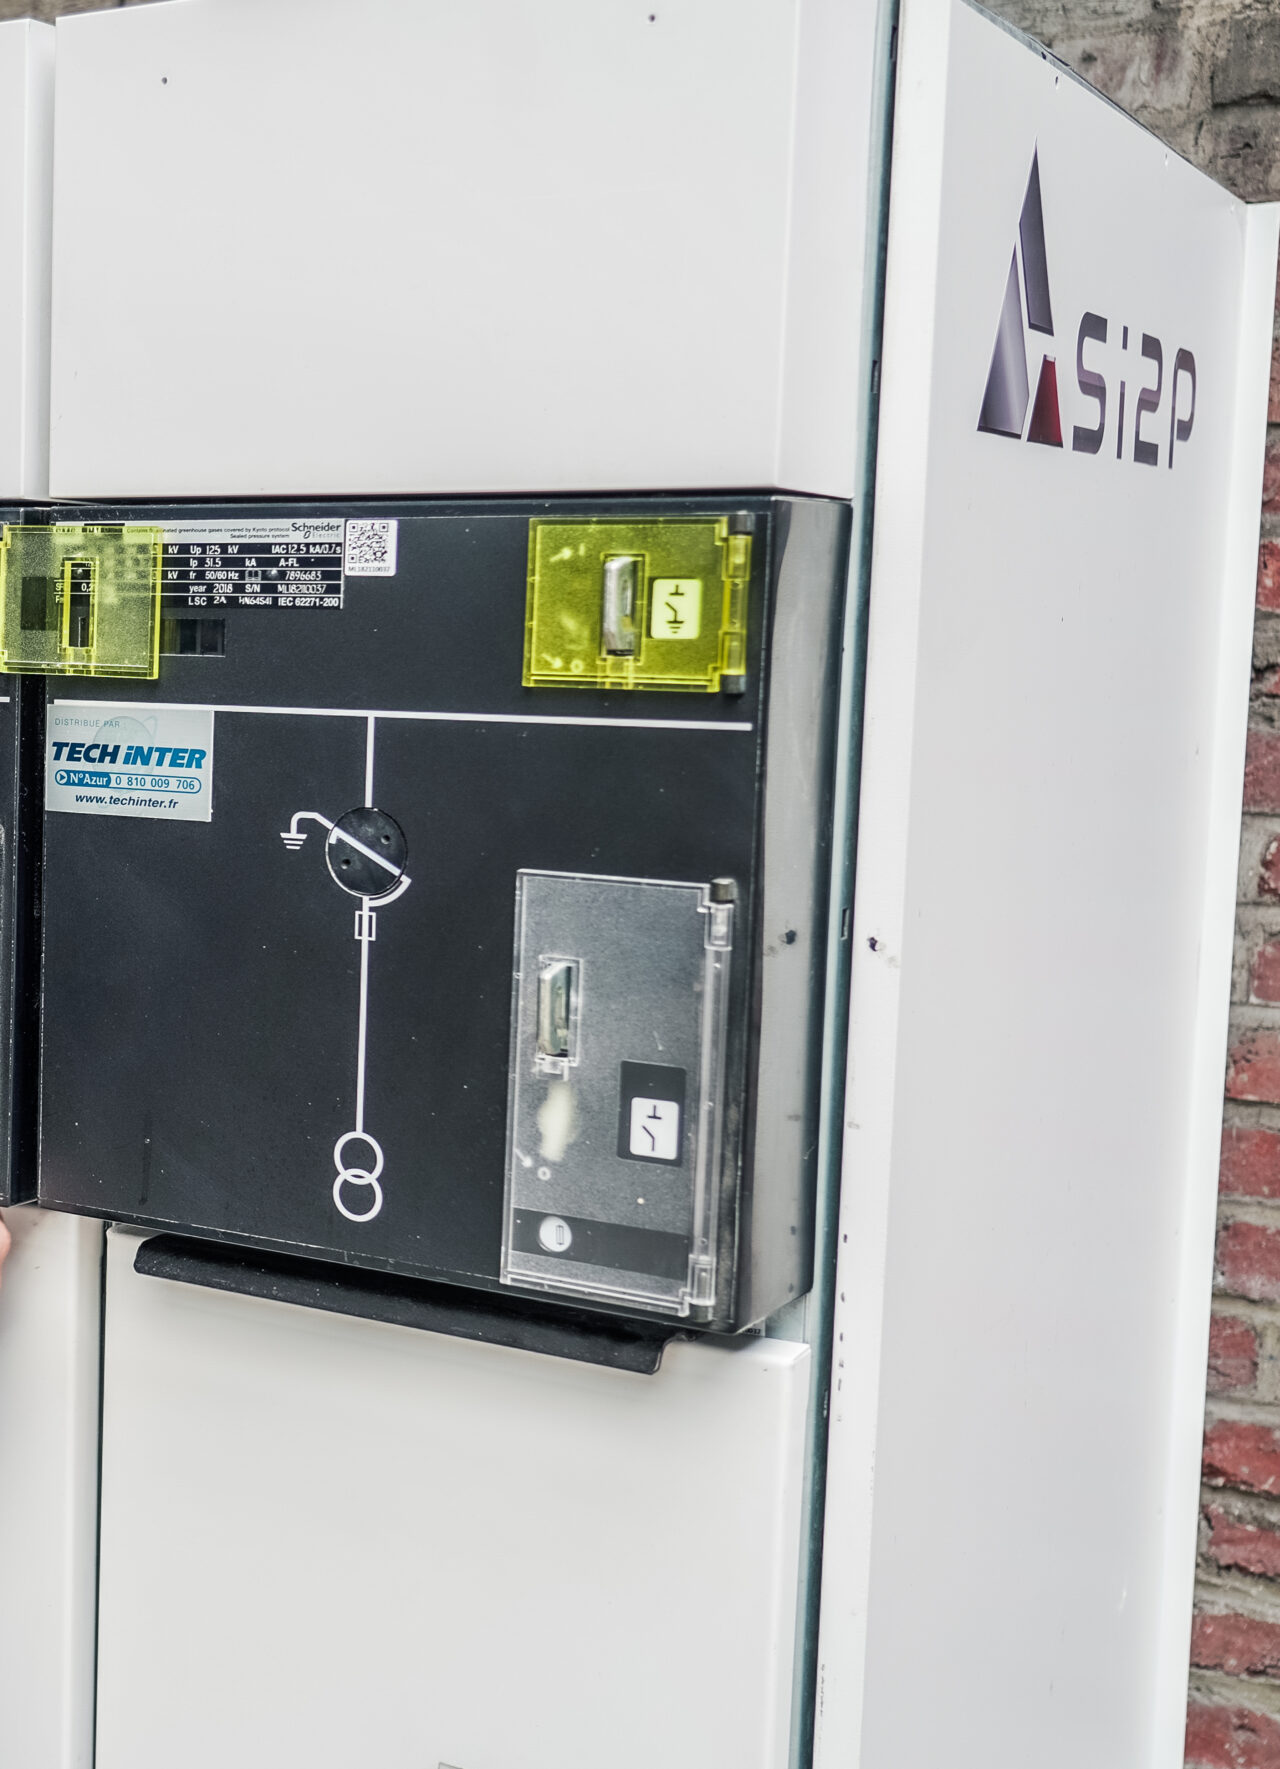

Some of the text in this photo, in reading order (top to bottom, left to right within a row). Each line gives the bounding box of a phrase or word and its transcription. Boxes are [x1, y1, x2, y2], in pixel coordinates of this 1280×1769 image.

[291, 522, 341, 532] Schneider
[168, 545, 179, 554] kV
[190, 545, 202, 555] Up
[206, 545, 221, 555] 125
[227, 545, 239, 554] kV
[272, 545, 287, 554] IAC
[204, 558, 222, 567] 31.5
[245, 558, 257, 567] kA
[279, 558, 299, 567] A-FL
[167, 571, 178, 580] kV
[205, 571, 227, 580] 50/60
[227, 571, 239, 580] Hz
[189, 585, 207, 594] year
[213, 583, 233, 593] 2018
[245, 584, 261, 593] S/N
[188, 596, 207, 606] LSC
[213, 596, 227, 604] 2A
[278, 597, 294, 606] IEC
[294, 597, 339, 607] 62271-200
[103, 720, 121, 728] PAR
[52, 741, 121, 764] TECH
[115, 776, 121, 786] 0
[127, 777, 146, 787] 810
[150, 778, 170, 789] 009
[176, 779, 195, 790] 706
[75, 794, 179, 809] www.techinter.fr
